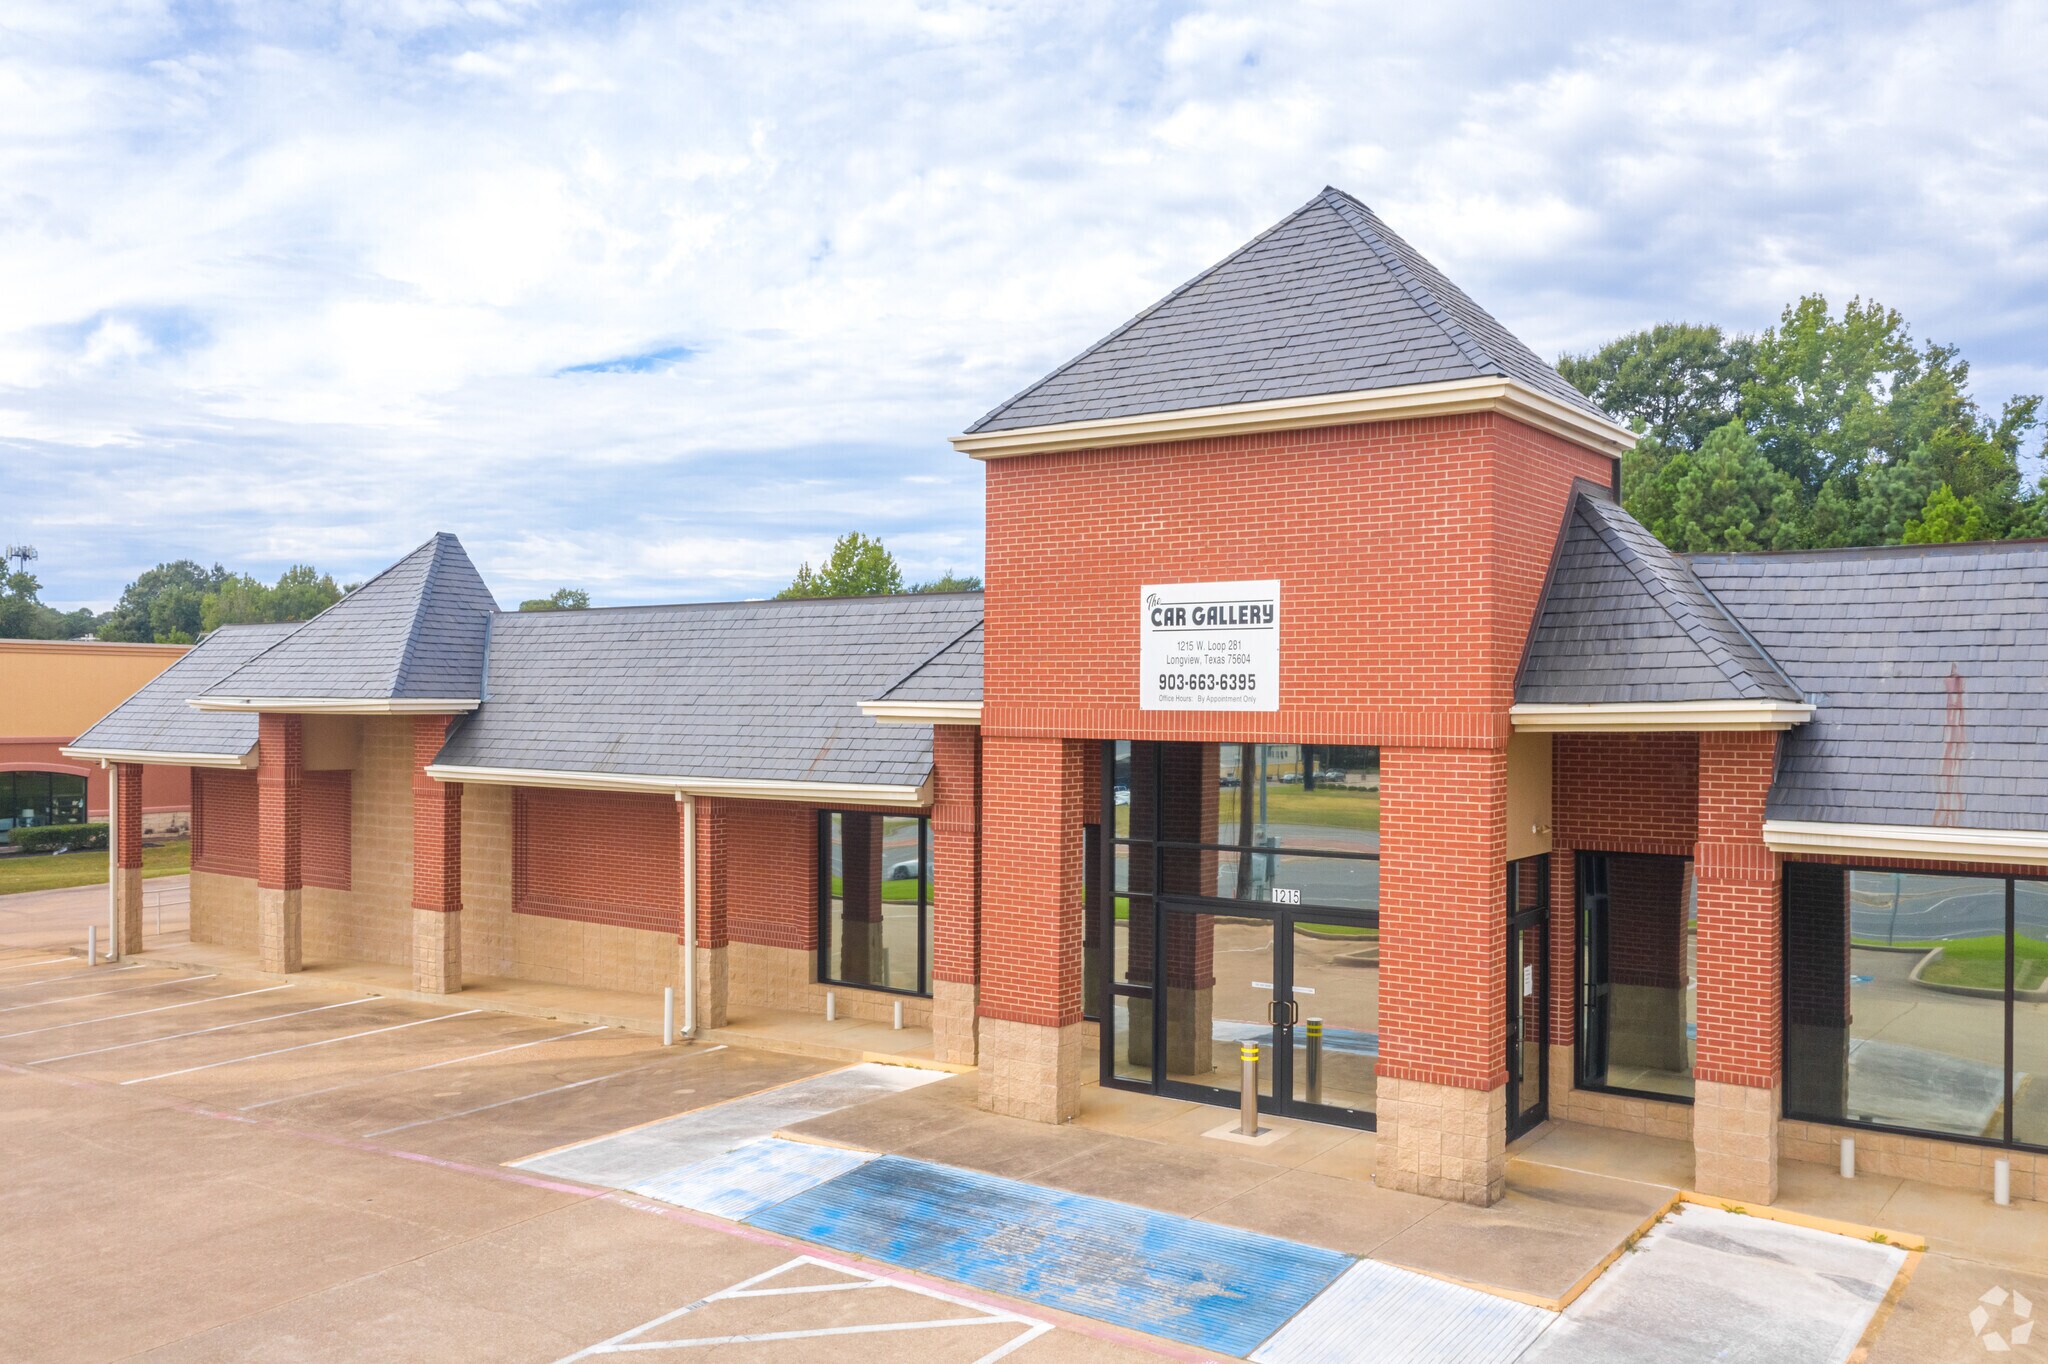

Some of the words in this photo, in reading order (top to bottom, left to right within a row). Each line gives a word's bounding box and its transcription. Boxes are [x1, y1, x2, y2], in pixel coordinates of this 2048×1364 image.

[1146, 593, 1161, 611] The
[1151, 607, 1186, 627] CAR
[1192, 604, 1274, 626] GALLERY
[1177, 640, 1194, 651] 1215
[1196, 640, 1205, 651] W.
[1208, 640, 1226, 652] Loop
[1228, 640, 1242, 651] 281
[1166, 654, 1202, 667] Longview,
[1204, 654, 1225, 665] Texas
[1228, 654, 1251, 664] 75604
[1159, 673, 1256, 691] 903-663-6395
[1197, 695, 1205, 703] By
[1206, 695, 1242, 703] Appointment
[1243, 695, 1257, 703] Only
[1275, 889, 1299, 903] 1215
